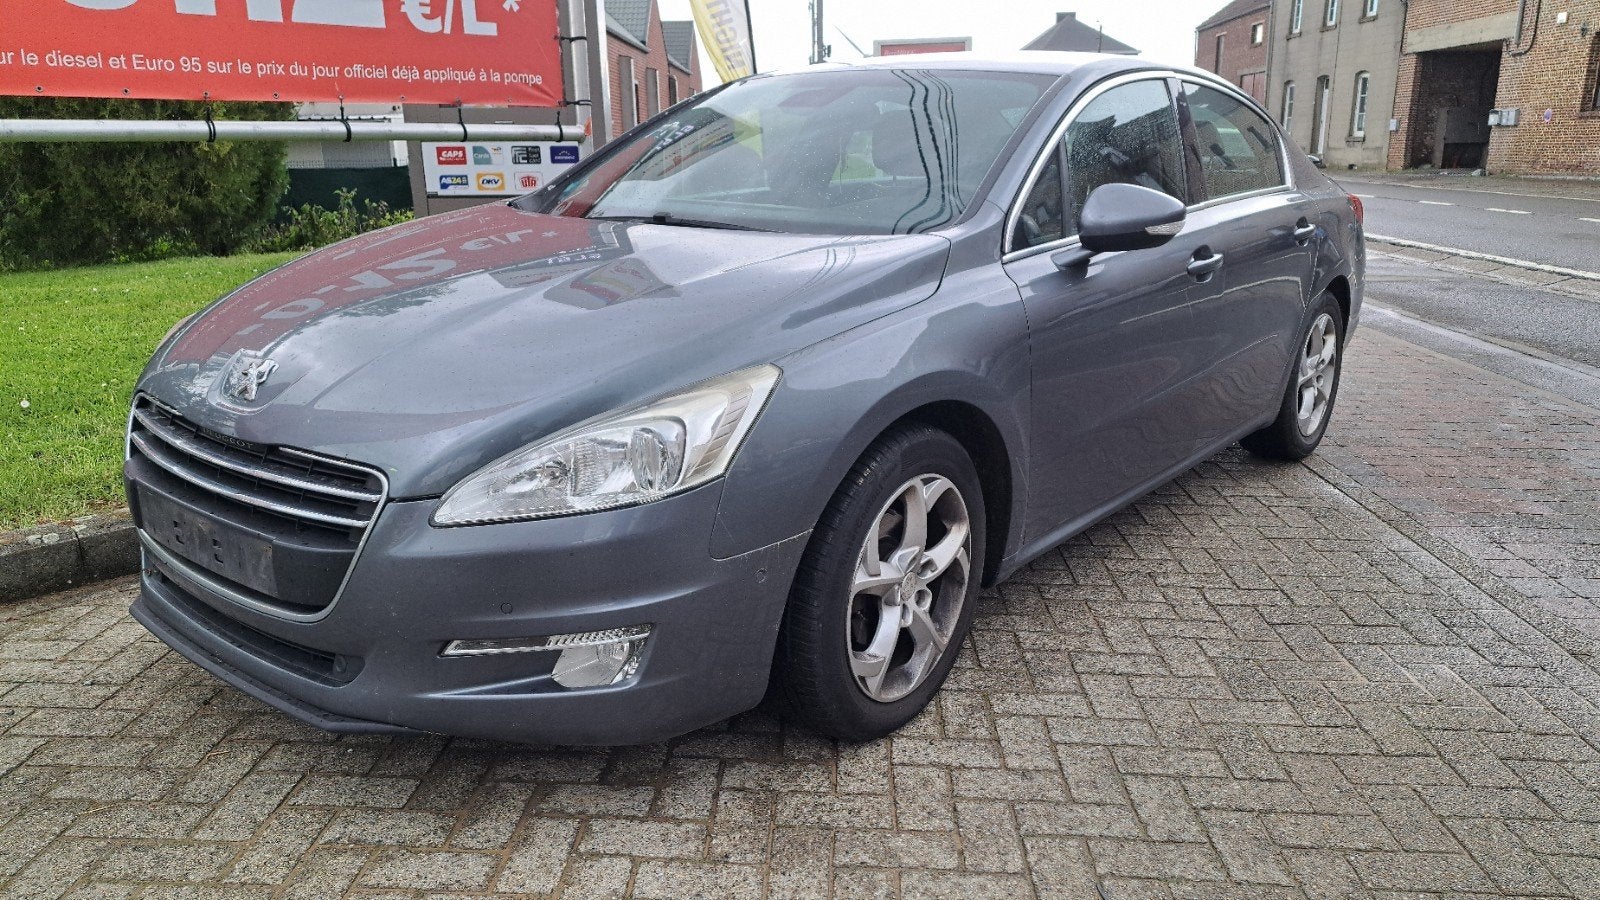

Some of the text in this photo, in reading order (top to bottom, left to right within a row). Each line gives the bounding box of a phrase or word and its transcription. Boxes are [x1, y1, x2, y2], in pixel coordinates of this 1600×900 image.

[21, 49, 38, 65] le
[45, 50, 102, 68] diesel
[109, 54, 127, 69] et
[132, 54, 174, 71] Euro
[180, 57, 201, 72] 95
[207, 62, 232, 73] sur
[238, 59, 251, 73] le
[257, 61, 285, 77] prix
[290, 61, 307, 76] du
[312, 63, 339, 80] jour
[344, 64, 388, 79] officiel
[392, 65, 420, 82] déjà
[424, 68, 475, 83] appliqué
[480, 68, 487, 82] à
[490, 69, 501, 82] la
[504, 72, 543, 86] pompe
[441, 150, 464, 158] CAPS
